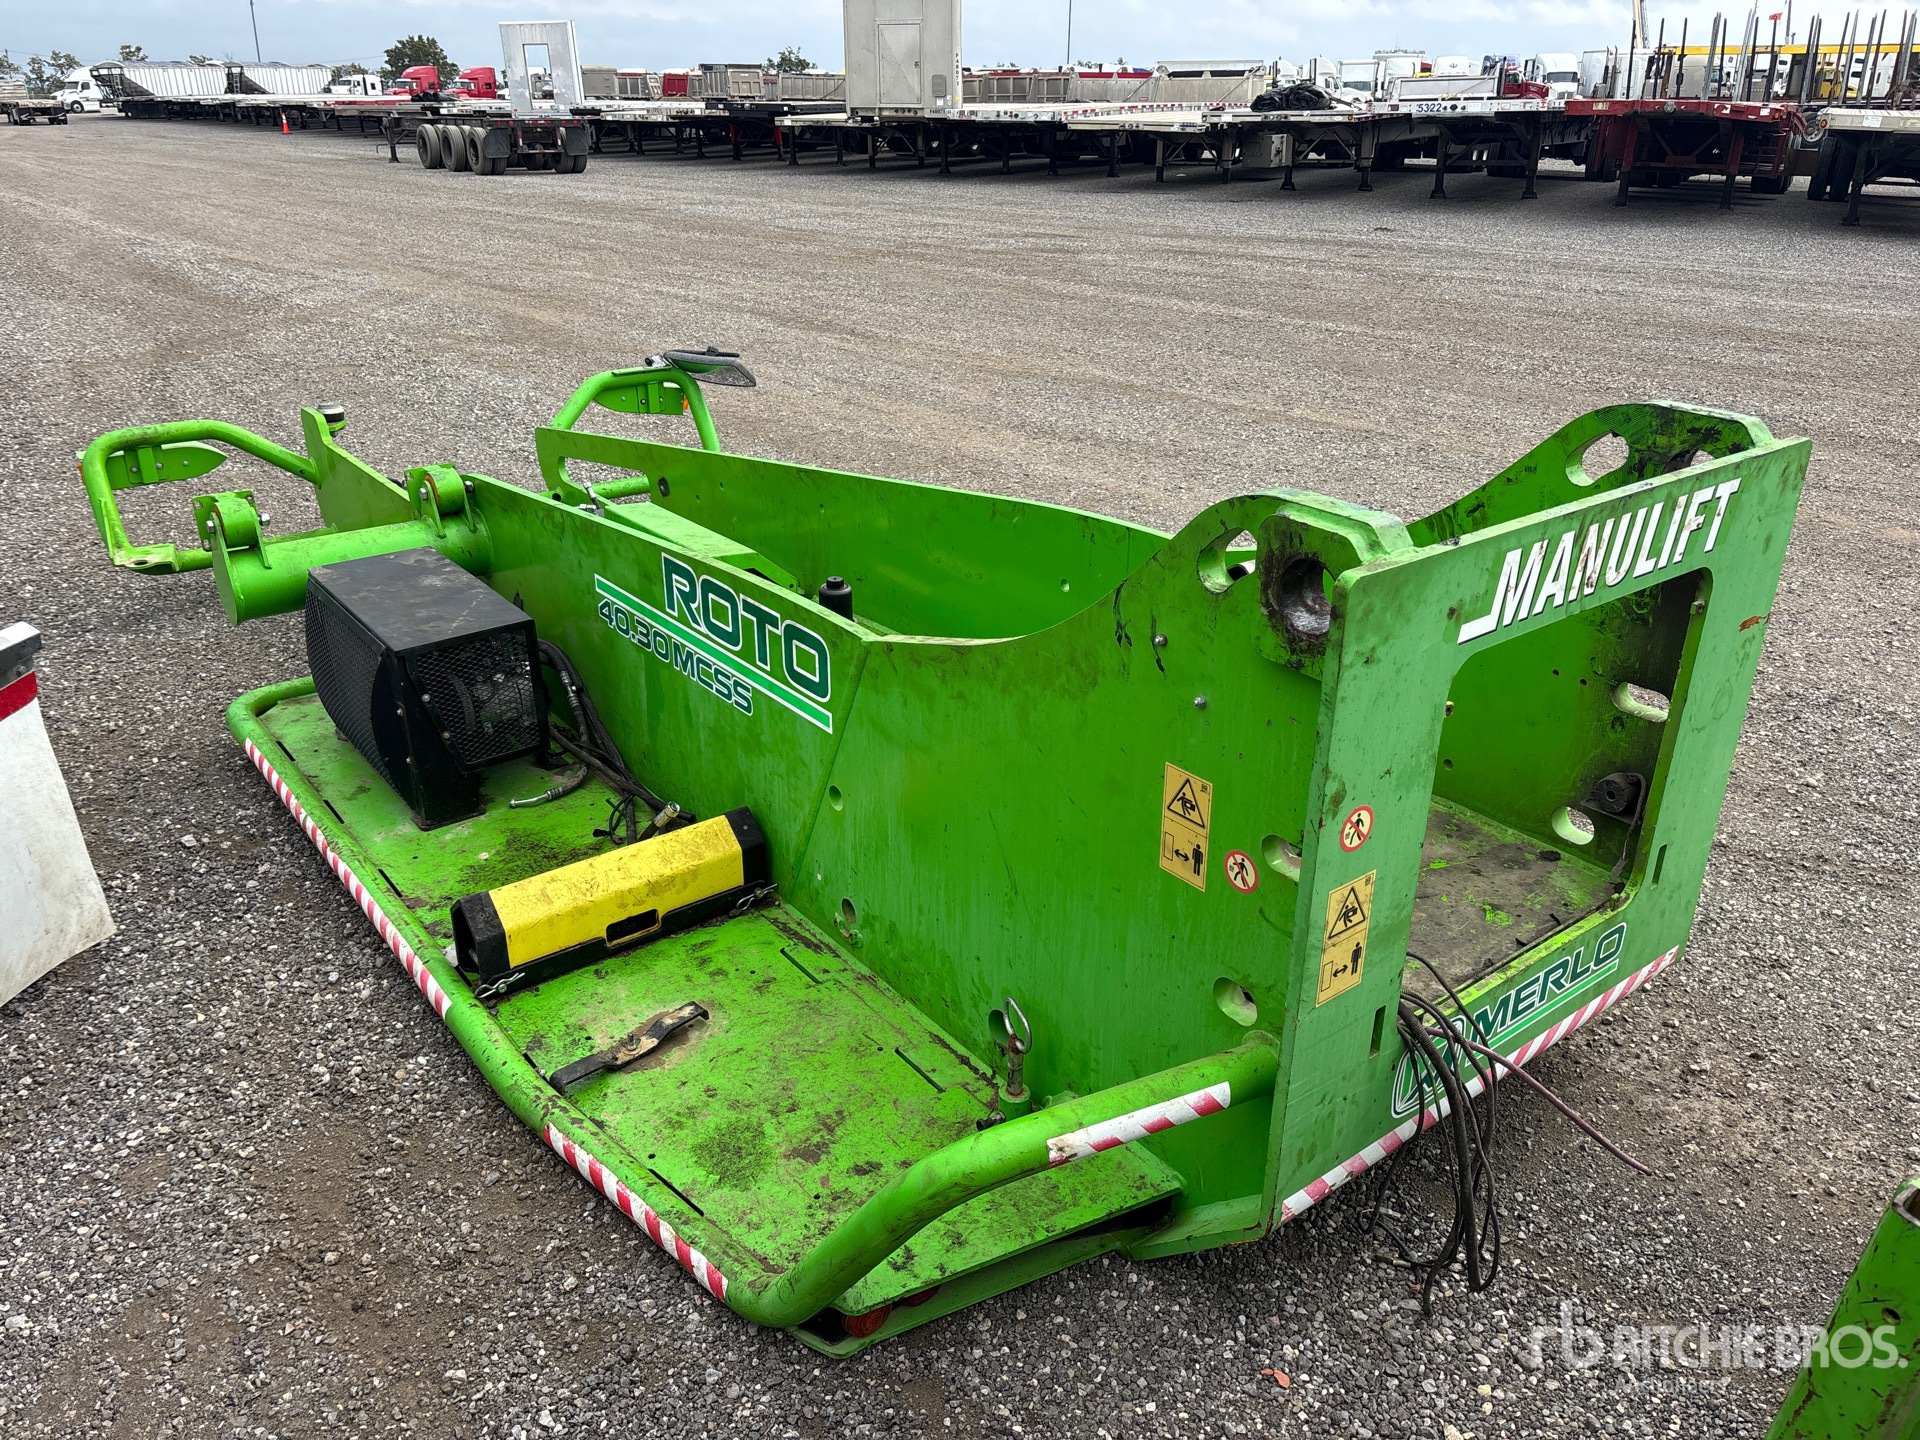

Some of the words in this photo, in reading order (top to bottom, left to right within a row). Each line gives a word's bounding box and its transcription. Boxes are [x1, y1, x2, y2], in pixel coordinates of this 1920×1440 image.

[1416, 102, 1442, 113] 5322
[1456, 477, 1742, 645] MANULIFT
[598, 597, 671, 662] 40.30
[671, 638, 754, 717] MCSS
[661, 551, 831, 703] ROTO
[1469, 921, 1627, 1044] MERLO
